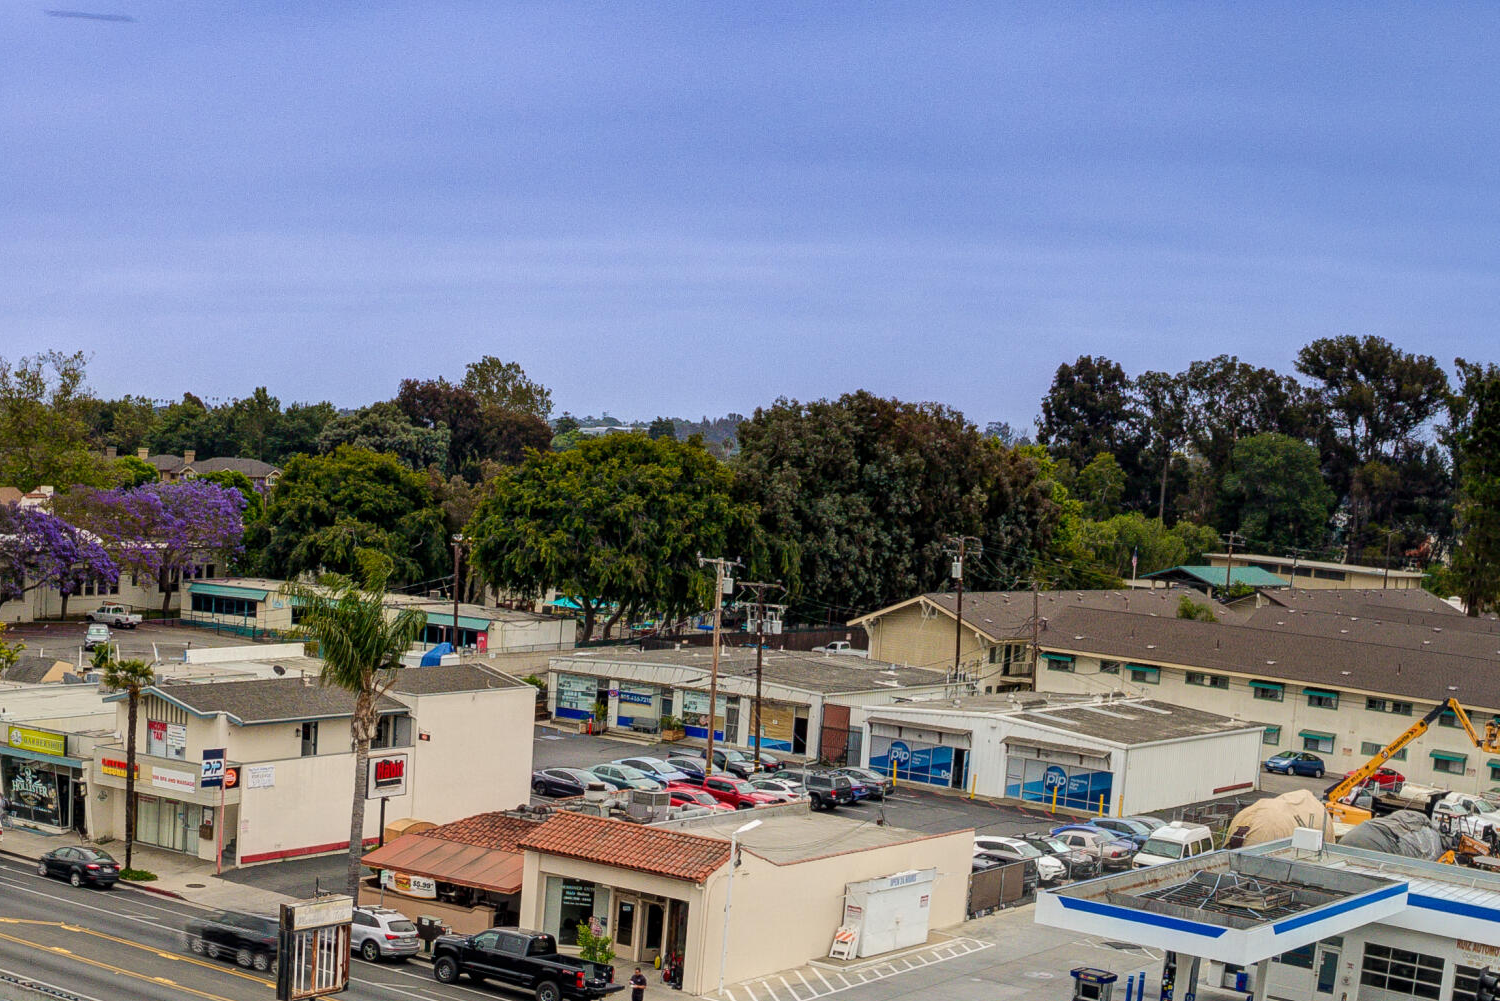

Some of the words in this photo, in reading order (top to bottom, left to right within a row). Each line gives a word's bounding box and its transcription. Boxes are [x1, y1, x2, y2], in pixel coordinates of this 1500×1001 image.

[153, 731, 163, 741] TAX
[890, 749, 910, 763] pip
[376, 759, 404, 780] Habit
[1046, 774, 1067, 788] pip
[11, 780, 49, 798] HOLLISTER
